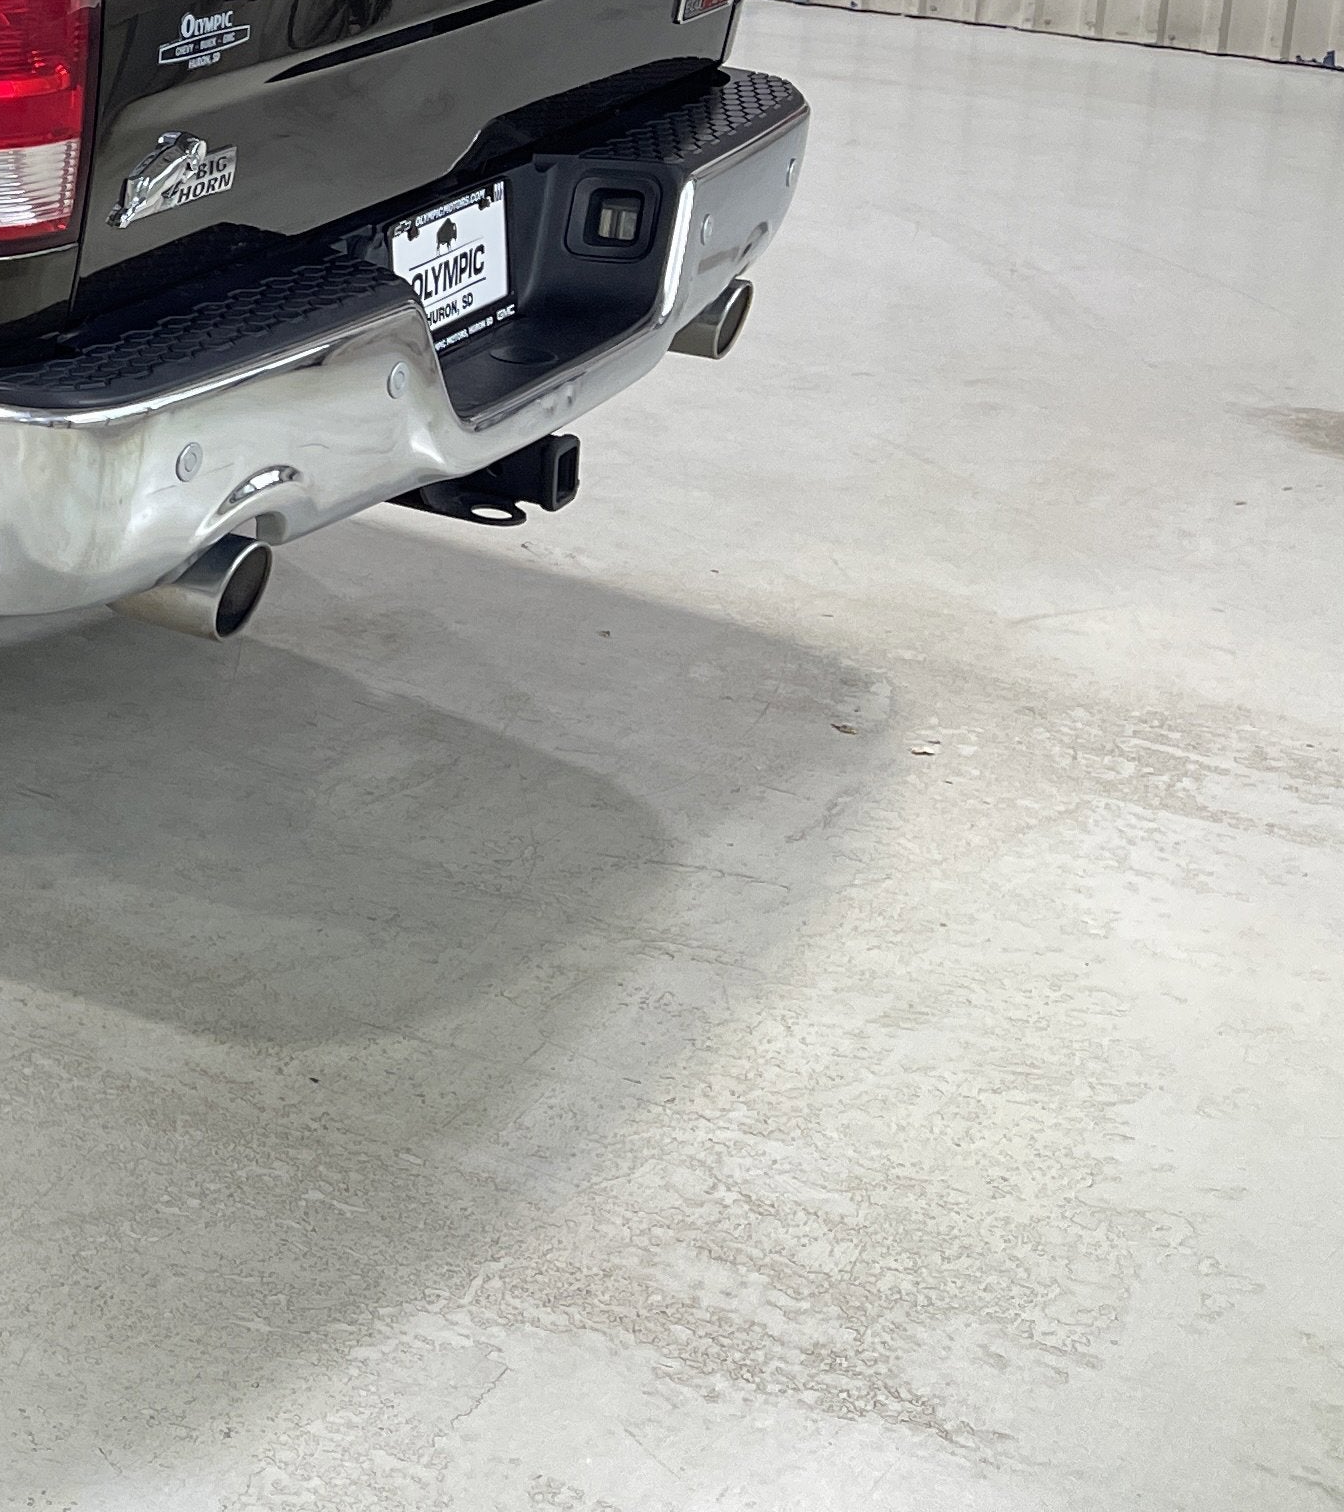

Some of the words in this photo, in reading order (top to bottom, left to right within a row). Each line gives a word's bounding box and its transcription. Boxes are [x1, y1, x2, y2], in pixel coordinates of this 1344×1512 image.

[181, 10, 234, 38] OLYMPIC
[196, 155, 228, 180] BIG
[177, 171, 233, 204] HORN
[412, 244, 486, 301] OLYMPIC
[426, 299, 460, 327] HURON,
[461, 292, 474, 310] SD
